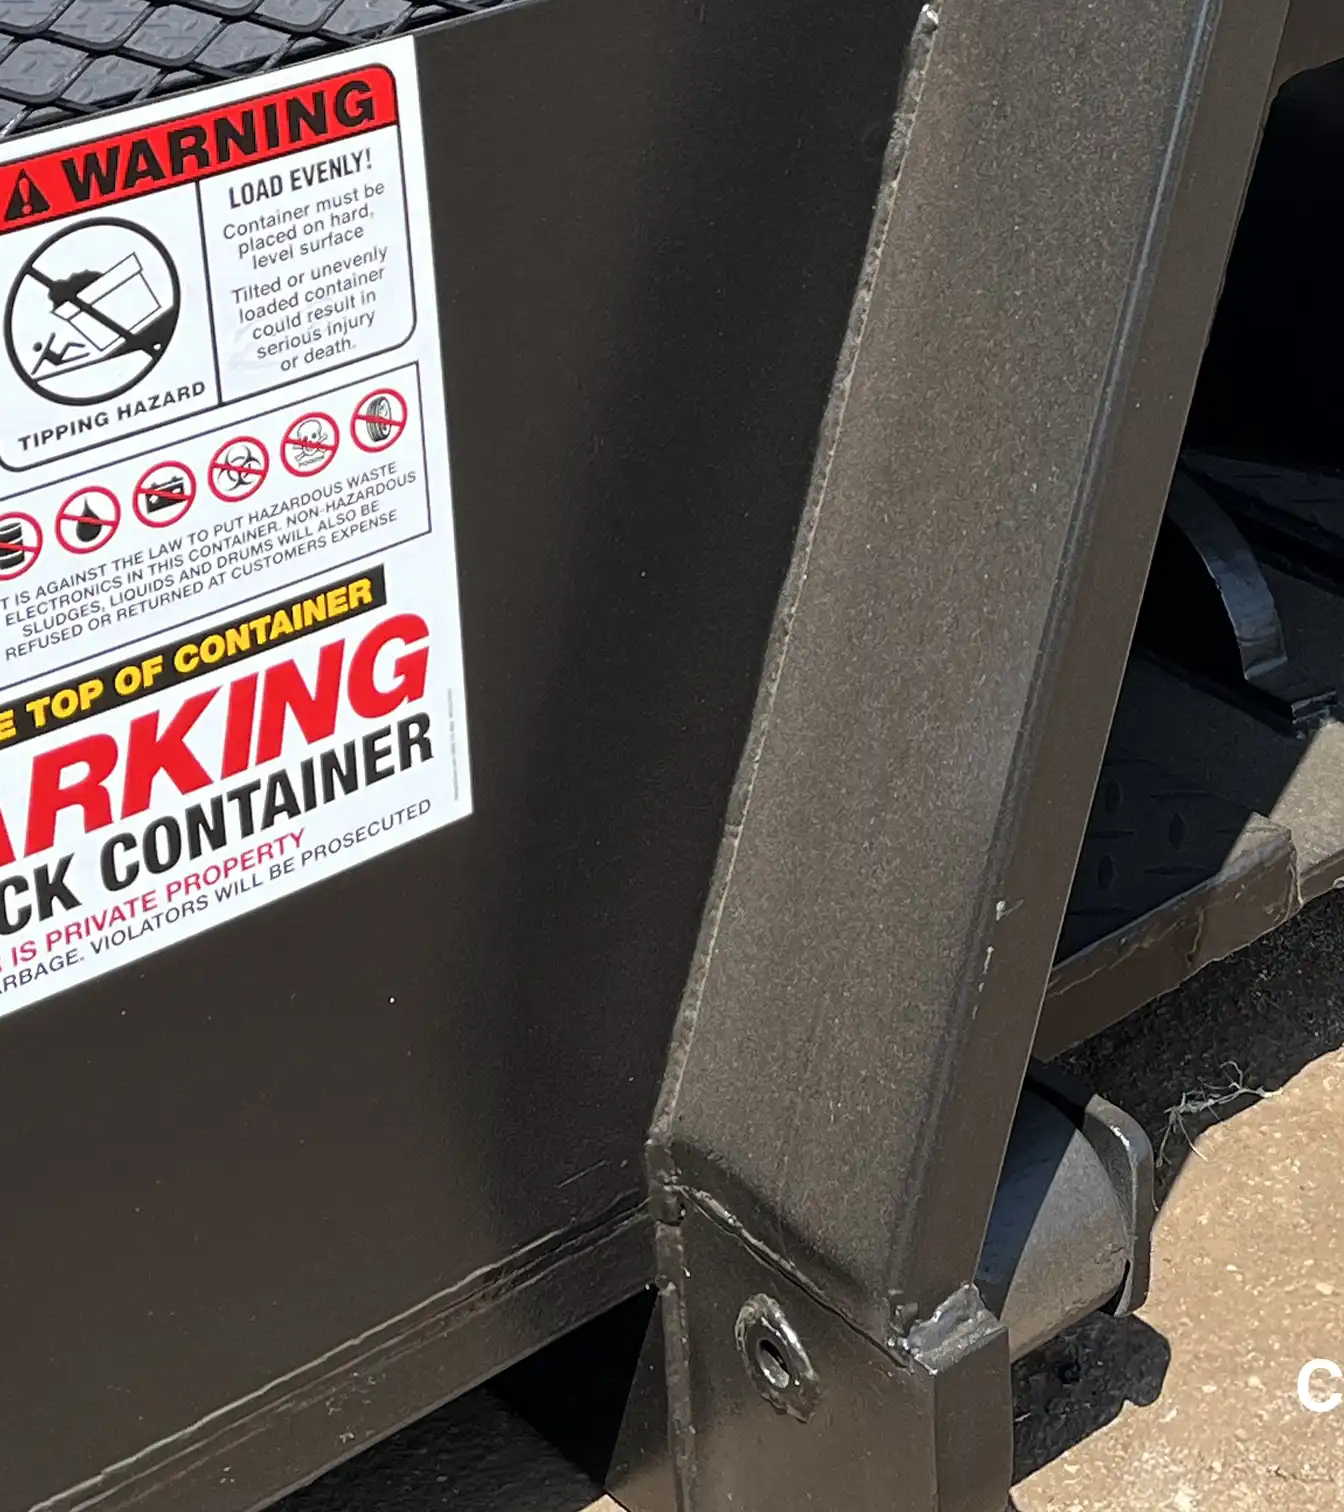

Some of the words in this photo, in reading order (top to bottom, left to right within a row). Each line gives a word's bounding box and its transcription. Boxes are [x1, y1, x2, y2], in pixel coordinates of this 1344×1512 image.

[64, 80, 375, 202] WARNING
[222, 204, 310, 240] Container
[316, 187, 359, 213] must
[364, 182, 385, 199] be
[228, 174, 283, 210] LOAD
[289, 147, 372, 192] EVENLY!
[238, 223, 298, 259] placed
[303, 219, 325, 236] on
[252, 244, 294, 270] level
[299, 226, 364, 256] surface
[231, 275, 282, 305] Tilted
[287, 272, 305, 288] or
[310, 246, 388, 281] unevenly
[239, 291, 299, 324] loaded
[304, 267, 385, 303] container
[252, 311, 302, 340] could
[307, 294, 356, 323] result
[360, 290, 377, 305] in
[256, 328, 322, 360] serious
[326, 310, 375, 337] injury
[280, 355, 299, 372] or
[303, 337, 356, 364] death.
[17, 411, 109, 451] TIPPING
[117, 381, 206, 421] HAZARD
[14, 590, 31, 607] IS
[35, 563, 108, 600] AGAINST
[111, 550, 144, 572] THE
[148, 537, 183, 561] LAW
[187, 528, 209, 546] TO
[213, 515, 244, 537] PUT
[248, 481, 344, 525] HAZARDOUS
[346, 461, 397, 489] WASTE
[22, 600, 105, 638] SLUDGES,
[109, 574, 175, 607] LIQUIDS
[179, 561, 212, 583] AND
[216, 538, 274, 569] DRUMS
[277, 526, 314, 547] WILL
[317, 508, 357, 533] ALSO
[360, 499, 380, 517] BE
[5, 623, 83, 662] REFUSED
[87, 613, 112, 631] OR
[116, 580, 204, 622] RETURNED
[208, 571, 227, 590] AT
[230, 535, 327, 580] CUSTOMERS
[331, 509, 397, 544] EXPENSE
[5, 575, 123, 627] ELECTRONICS
[127, 568, 143, 585] IN
[147, 554, 185, 576] THIS
[25, 679, 104, 729] TOP
[114, 655, 163, 696] OF
[174, 578, 373, 673] CONTAINER
[100, 712, 434, 892] CONTAINER
[11, 940, 38, 967] IS
[45, 889, 158, 953] PRIVATE
[166, 827, 305, 903] PROPERTY
[89, 894, 209, 955] VIOLATORS
[214, 873, 264, 903] WILL
[269, 856, 295, 881] BE
[301, 798, 431, 867] PROSECUTED
